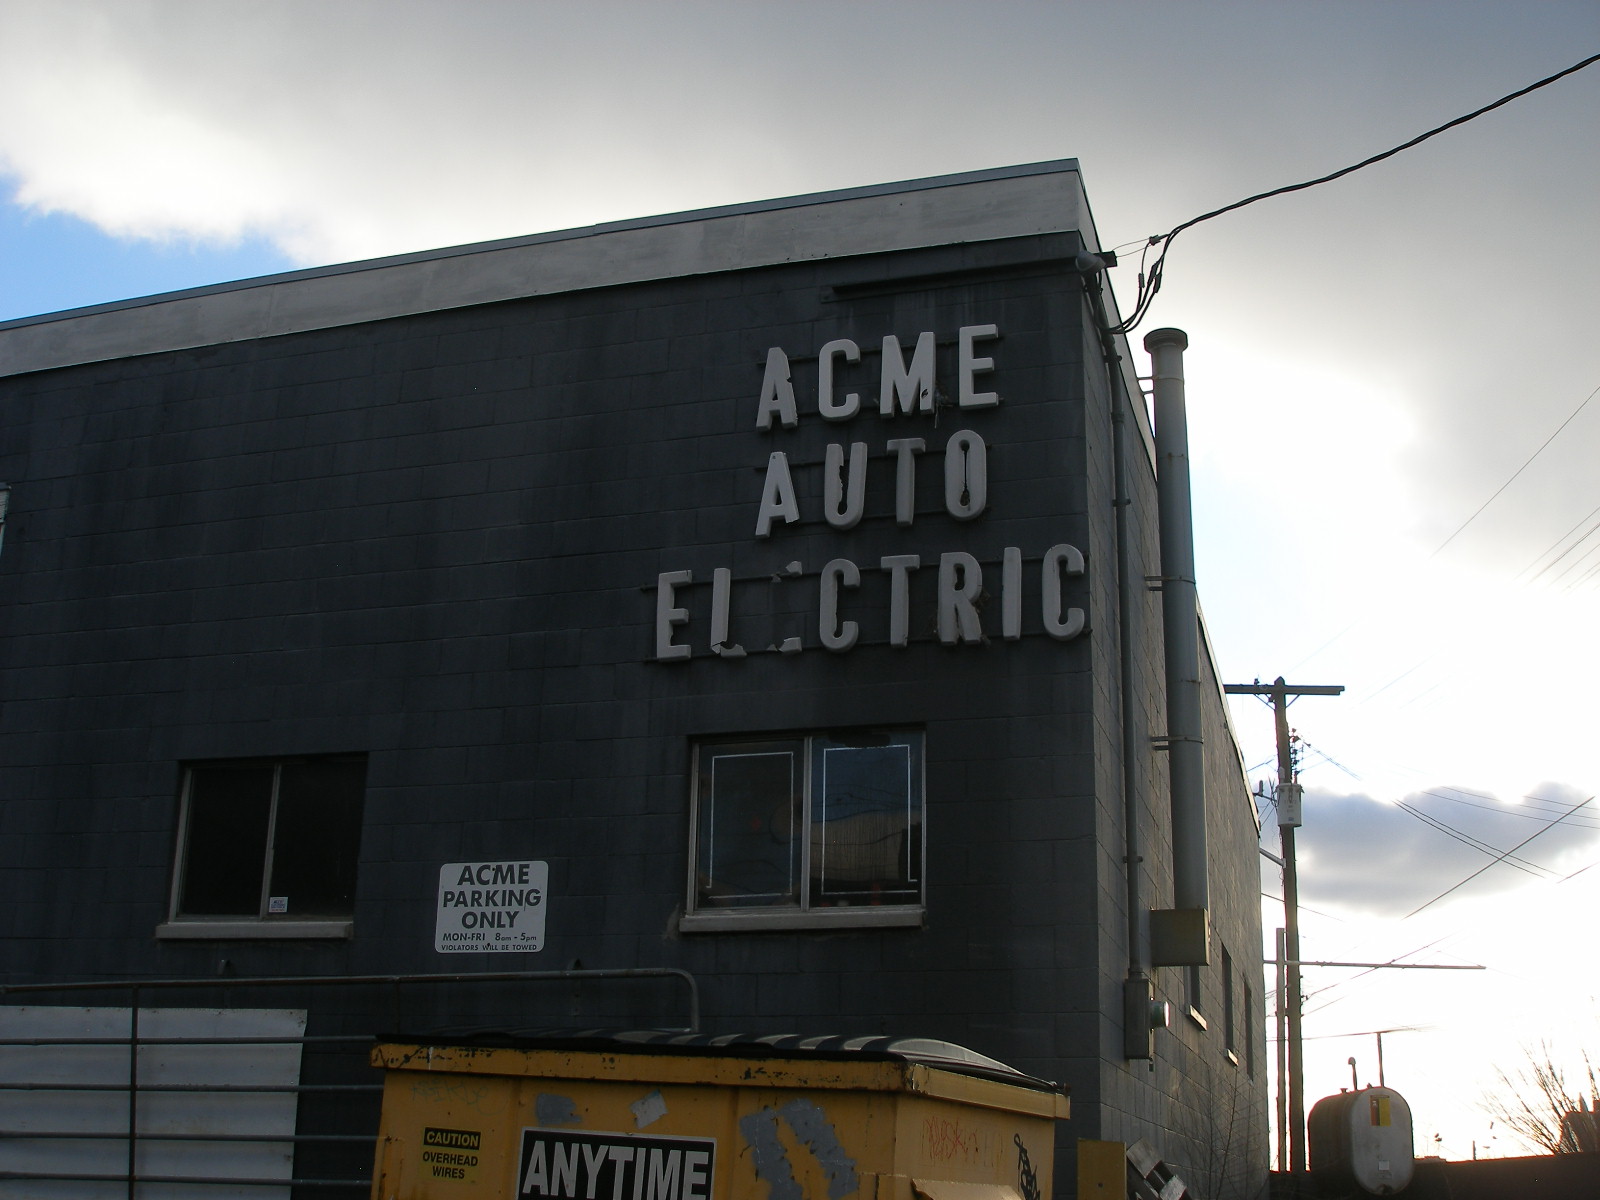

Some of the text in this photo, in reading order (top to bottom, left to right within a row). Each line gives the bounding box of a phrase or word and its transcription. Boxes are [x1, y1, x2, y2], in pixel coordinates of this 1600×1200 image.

[756, 324, 999, 430] ACME
[755, 430, 988, 537] AUTO
[655, 544, 1086, 661] ELCTRIC
[457, 864, 530, 886] ACME
[443, 889, 541, 908] PARKING
[461, 911, 520, 929] ONLY
[442, 932, 486, 941] MON-FRI
[495, 932, 511, 941] 8am
[520, 932, 537, 942] 5pm
[426, 1131, 479, 1148] CAUTION
[422, 1151, 479, 1167] OVERHEAD
[432, 1165, 465, 1180] WIRES
[522, 1140, 710, 1200] ANYTIME
